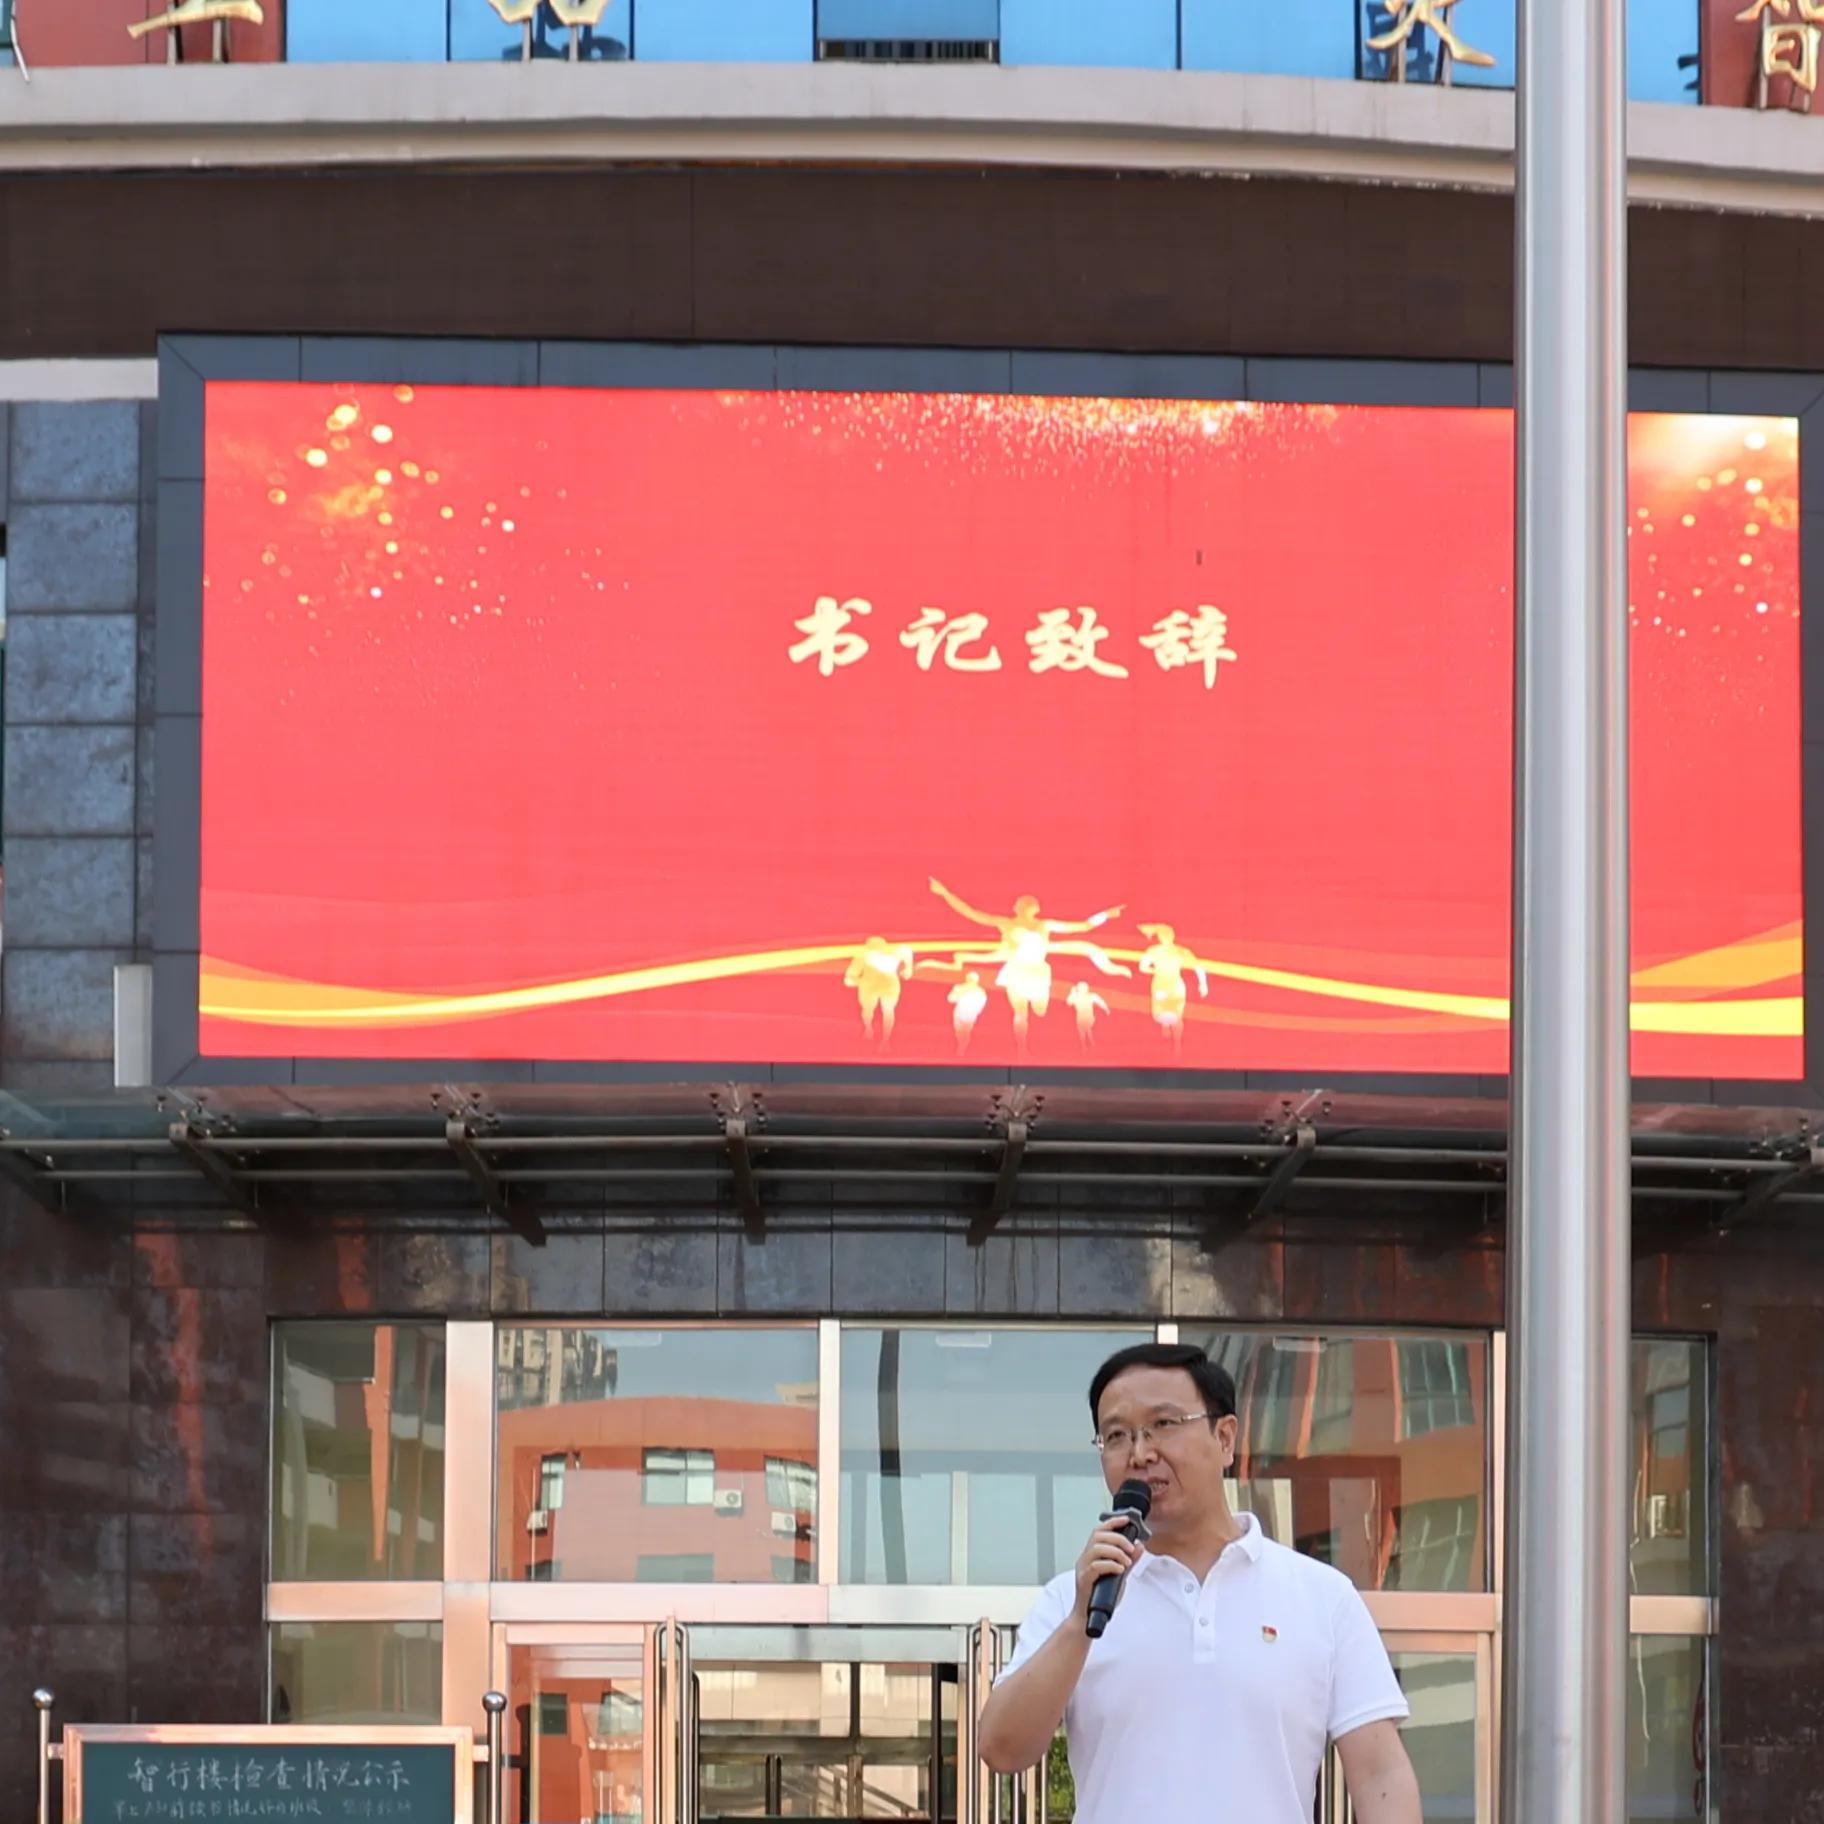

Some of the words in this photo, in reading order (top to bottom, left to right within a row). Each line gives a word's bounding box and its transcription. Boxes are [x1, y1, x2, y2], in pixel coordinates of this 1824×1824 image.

[787, 596, 1238, 689] 书记致辞
[127, 1755, 411, 1794] 智行楼检查情况公示
